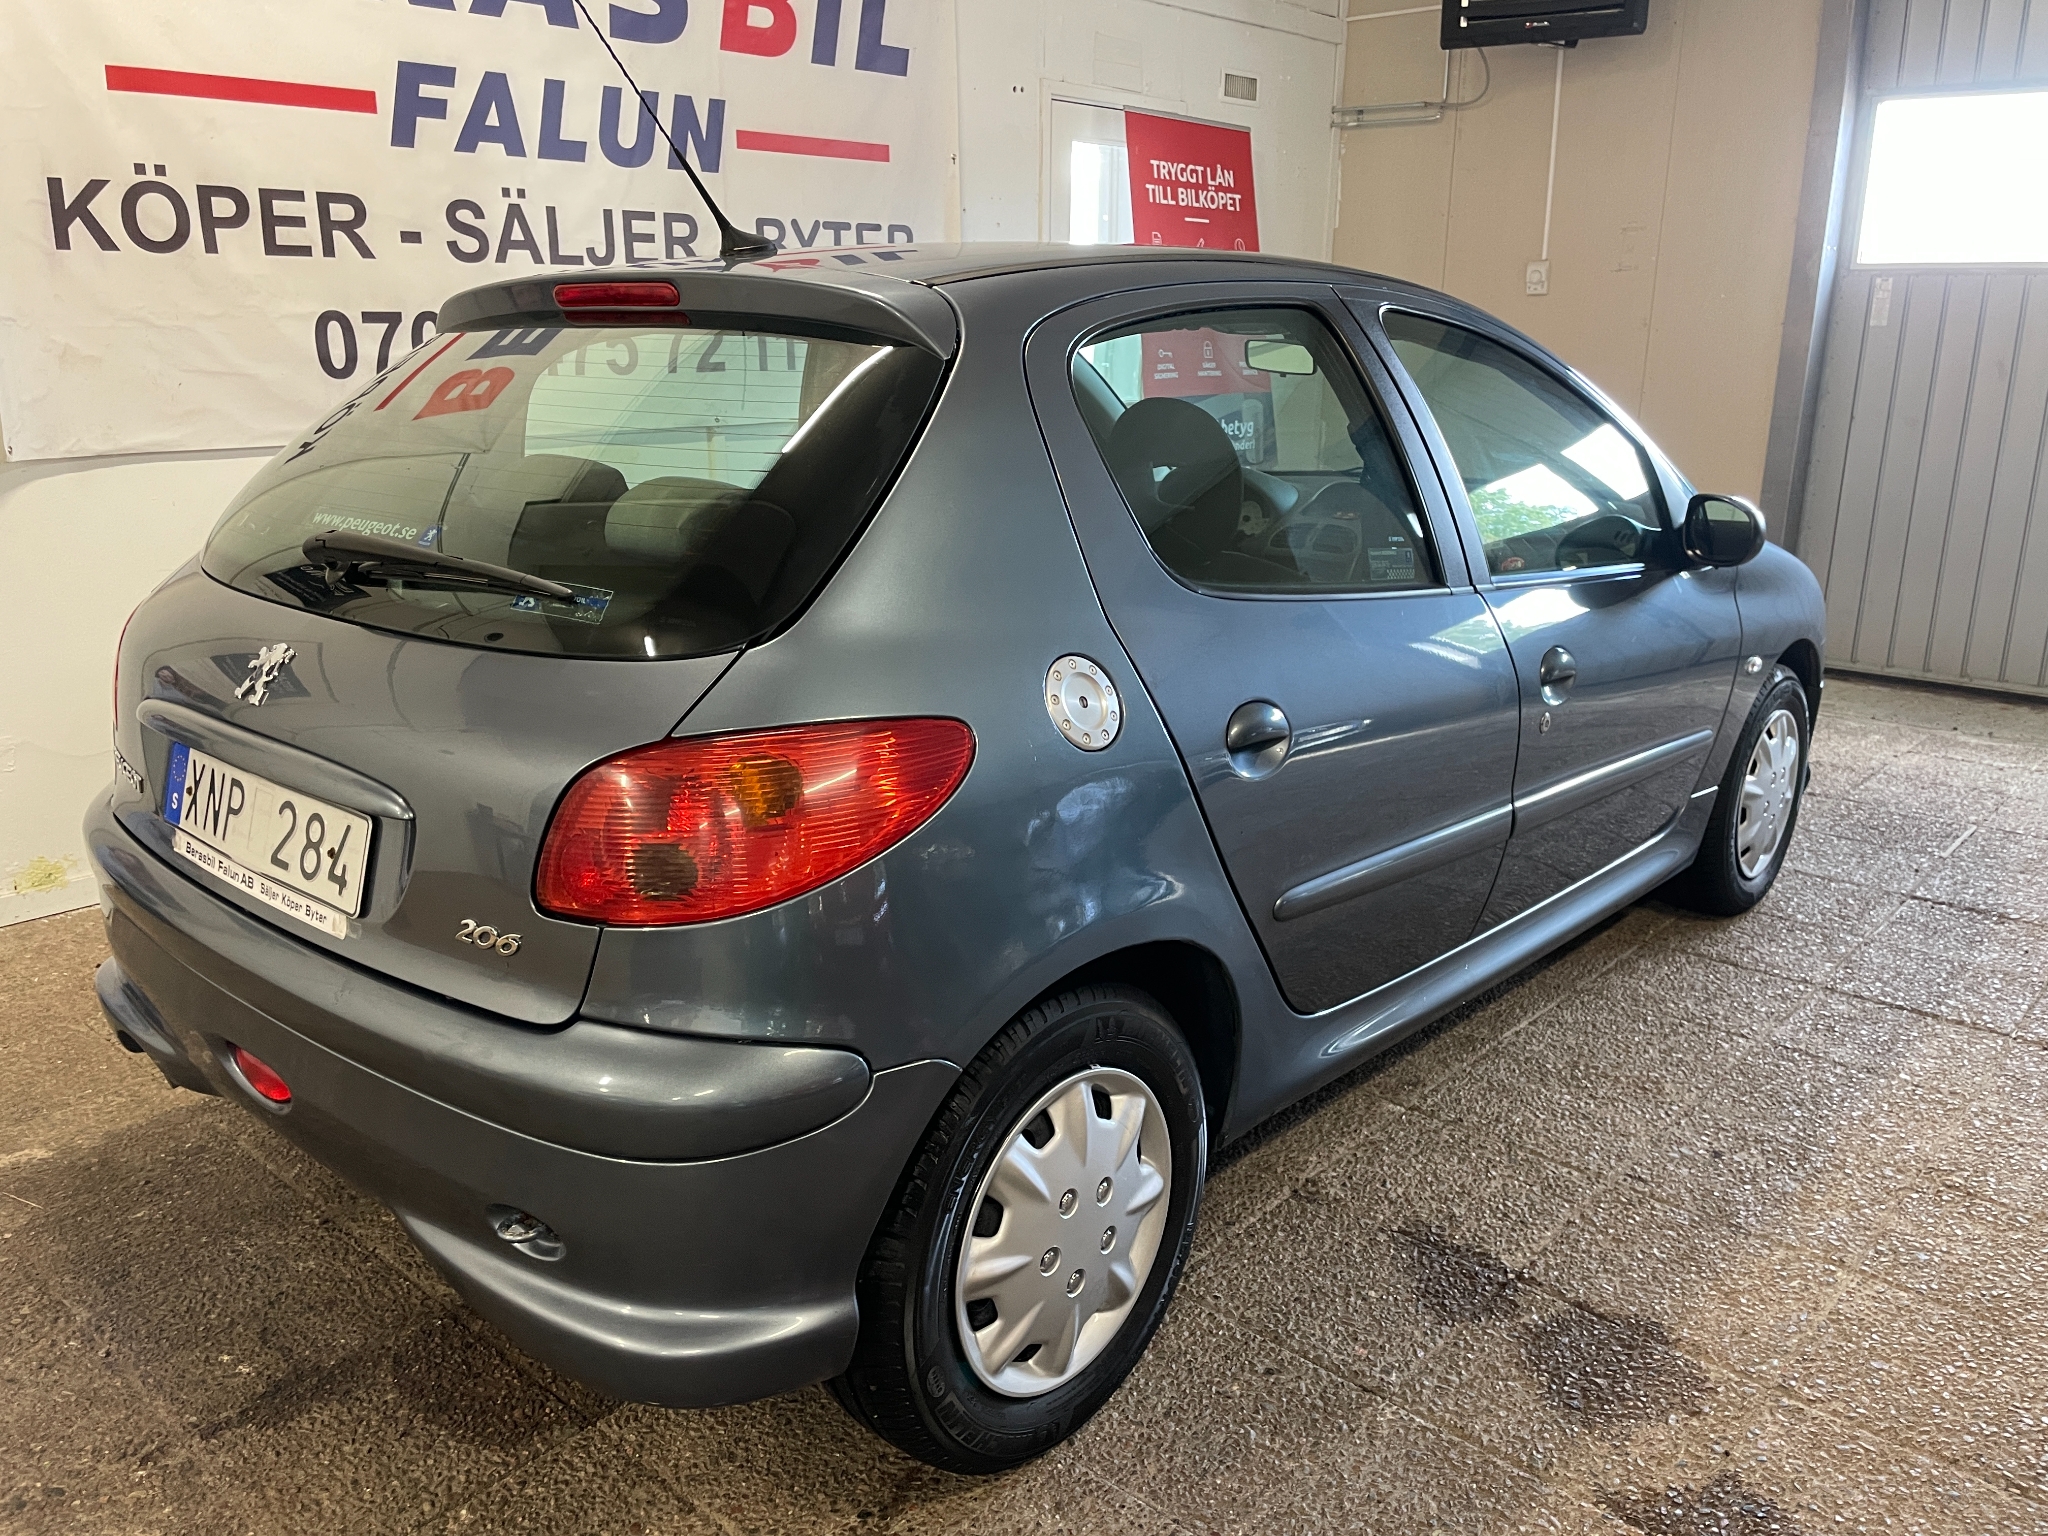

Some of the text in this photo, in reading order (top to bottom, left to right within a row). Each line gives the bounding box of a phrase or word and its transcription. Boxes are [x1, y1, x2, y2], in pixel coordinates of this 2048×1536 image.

[390, 60, 727, 174] FALUN
[1149, 159, 1235, 188] TRYGGT LÅN
[46, 162, 377, 260] KÖPER
[445, 187, 699, 267] SÄLJER
[1145, 183, 1241, 212] TILL BILKÖPET
[312, 512, 417, 540] www.peugeot.se
[171, 792, 179, 810] S
[185, 758, 246, 841] XNP
[268, 800, 352, 897] 284
[185, 841, 328, 925] Berasbil Falun AB Säljer Köper Byter
[454, 918, 522, 957] 206
